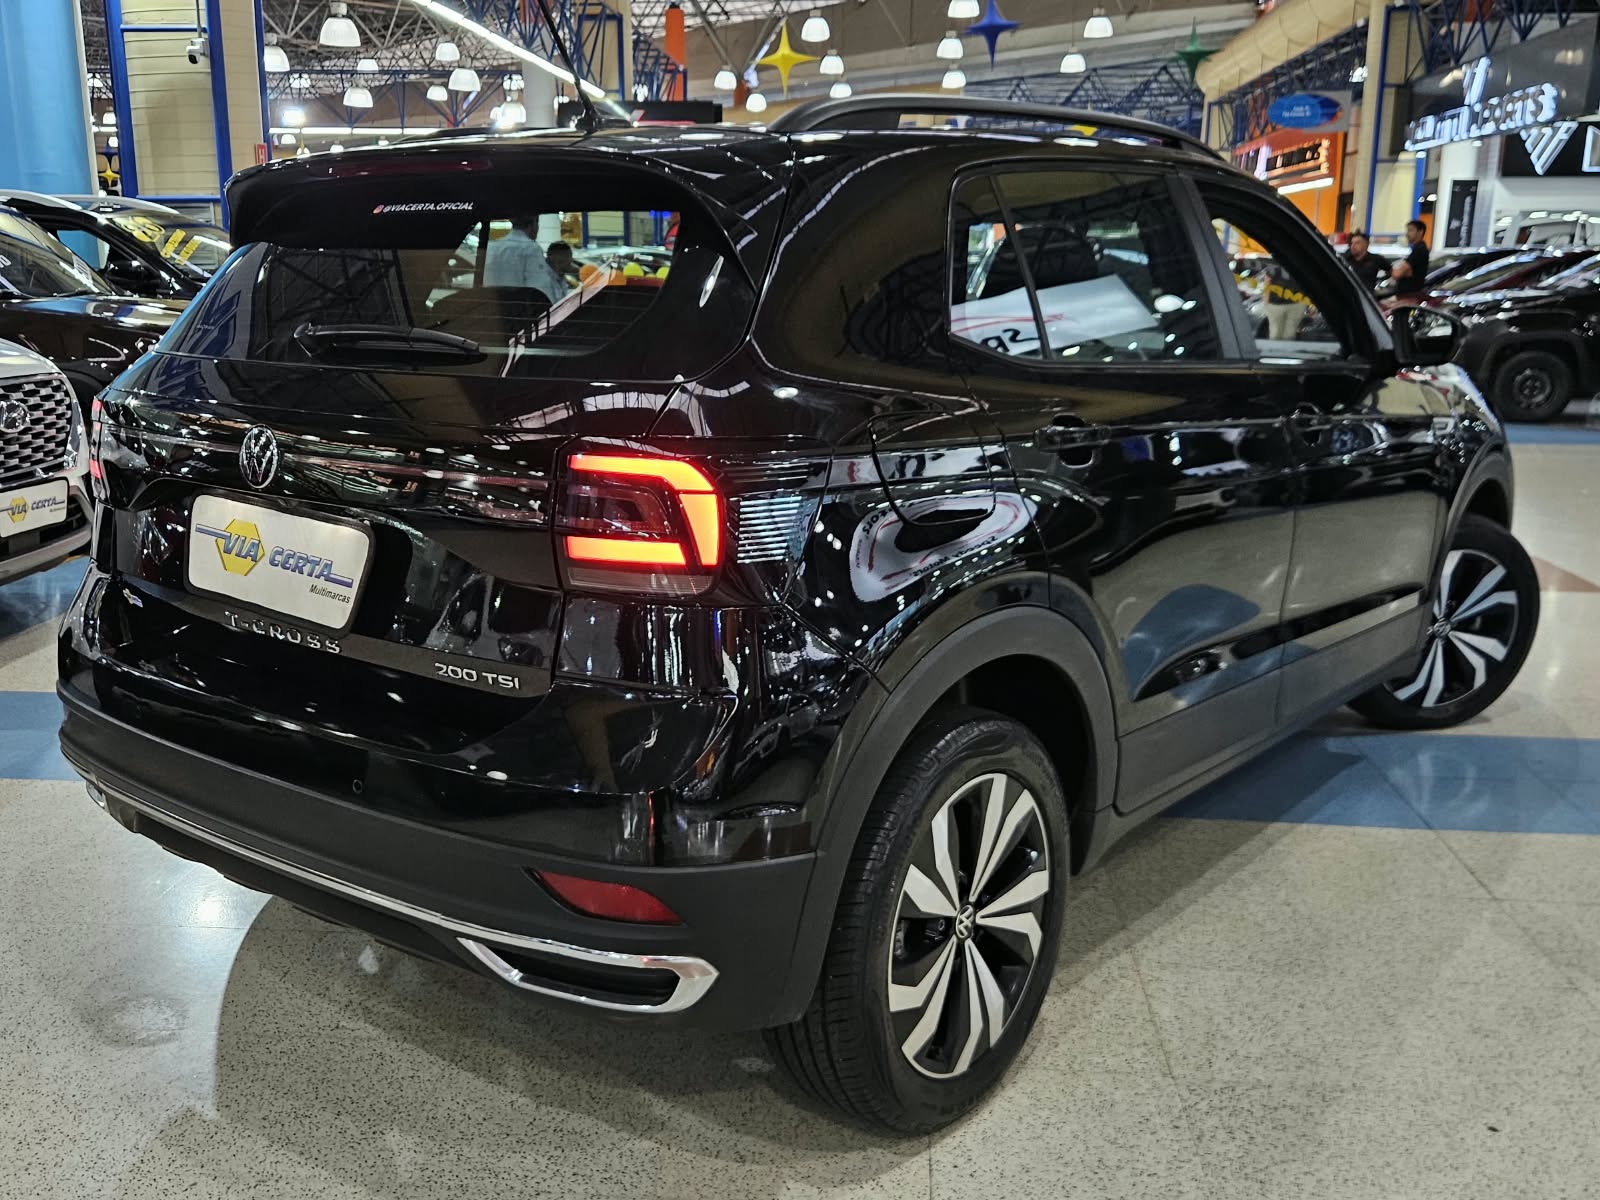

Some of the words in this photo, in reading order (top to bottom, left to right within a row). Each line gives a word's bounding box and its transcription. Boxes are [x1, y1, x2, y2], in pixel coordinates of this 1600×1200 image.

[383, 202, 474, 213] @VIACERTA.OFICIAL
[11, 503, 27, 516] VIA
[224, 533, 261, 562] VIA
[268, 545, 333, 582] CERTA
[309, 584, 351, 604] Multimarcas
[224, 611, 341, 654] T-CROSS
[434, 662, 478, 682] 200
[481, 671, 519, 689] TSI
